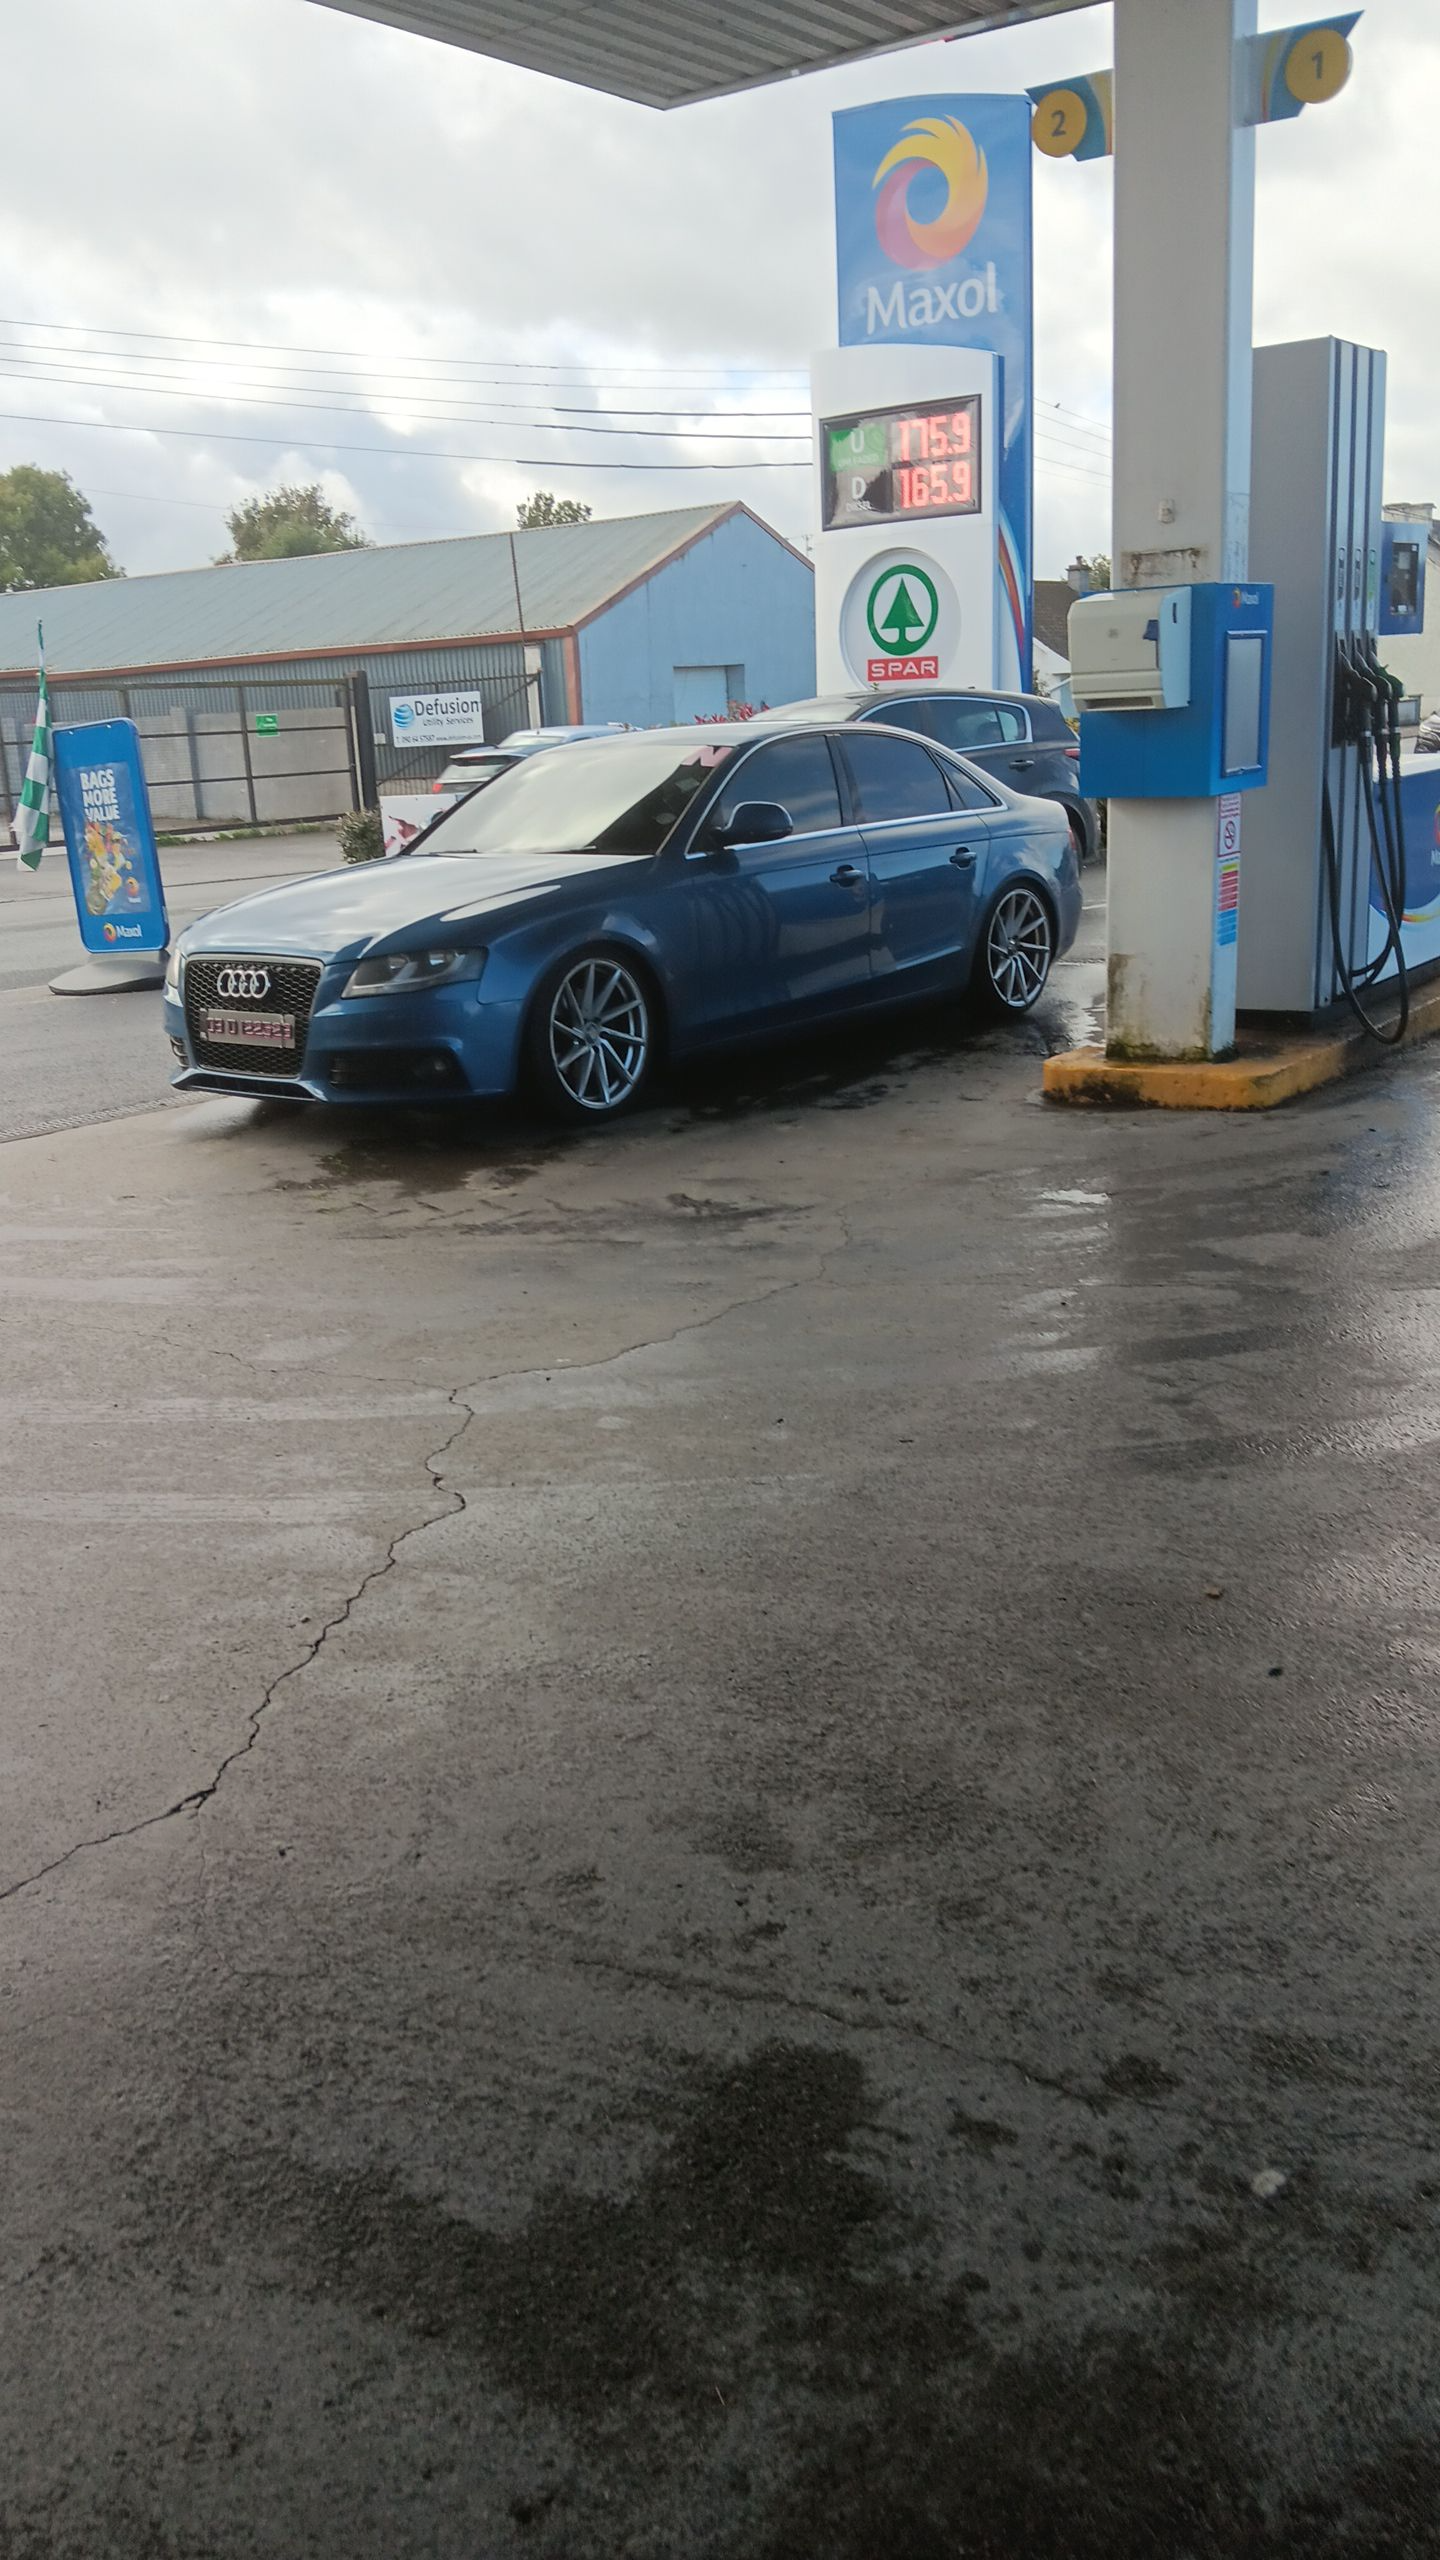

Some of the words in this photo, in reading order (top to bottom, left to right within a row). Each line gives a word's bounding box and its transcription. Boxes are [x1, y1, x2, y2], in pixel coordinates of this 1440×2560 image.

[1311, 51, 1323, 80] 1
[1051, 110, 1066, 137] 2
[867, 261, 998, 335] Maxol
[852, 476, 866, 500] D
[898, 460, 972, 509] 165.9
[871, 660, 936, 677] SPAR
[414, 697, 479, 716] Defusion
[446, 717, 474, 725] Services
[80, 769, 115, 790] BAGS
[82, 787, 118, 807] MORE
[84, 804, 120, 822] VALUE
